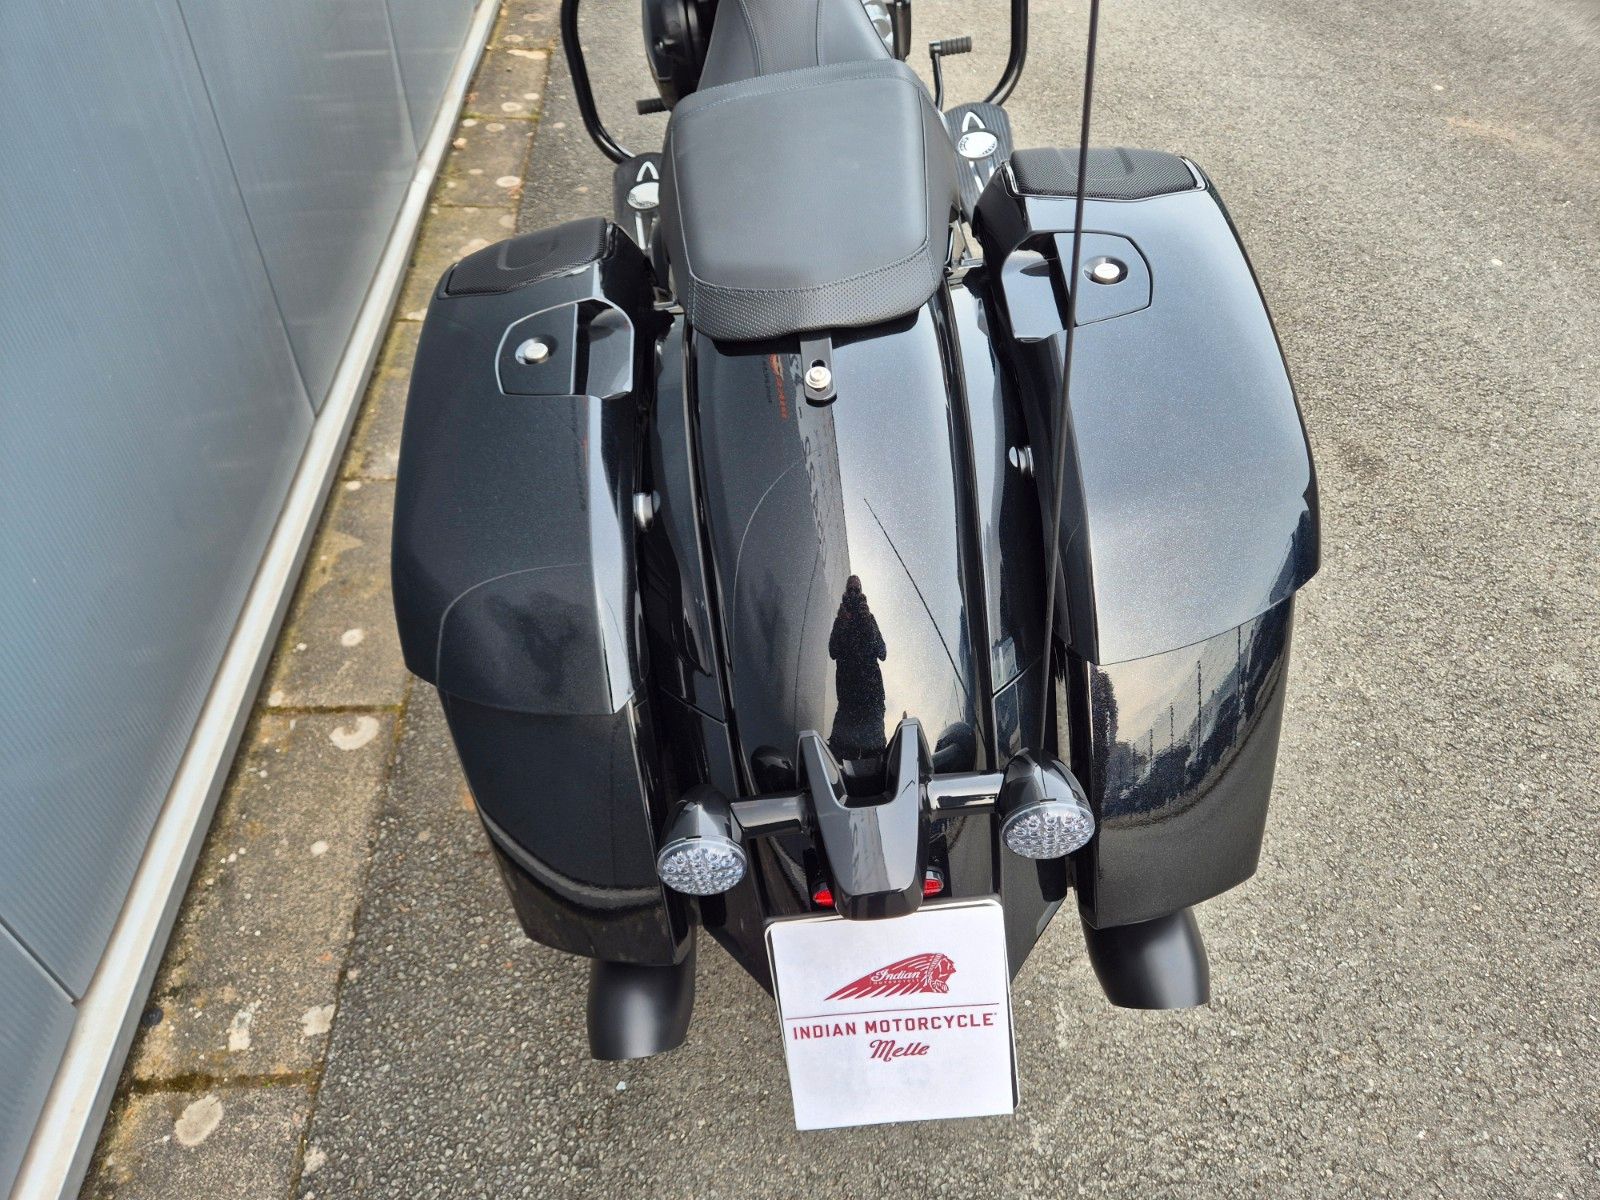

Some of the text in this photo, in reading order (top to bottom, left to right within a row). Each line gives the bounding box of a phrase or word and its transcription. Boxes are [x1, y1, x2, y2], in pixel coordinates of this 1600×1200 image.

[870, 968, 921, 982] Indian
[792, 1013, 994, 1040] INDIAN MOTORCYCLE
[869, 1039, 931, 1062] Melle
